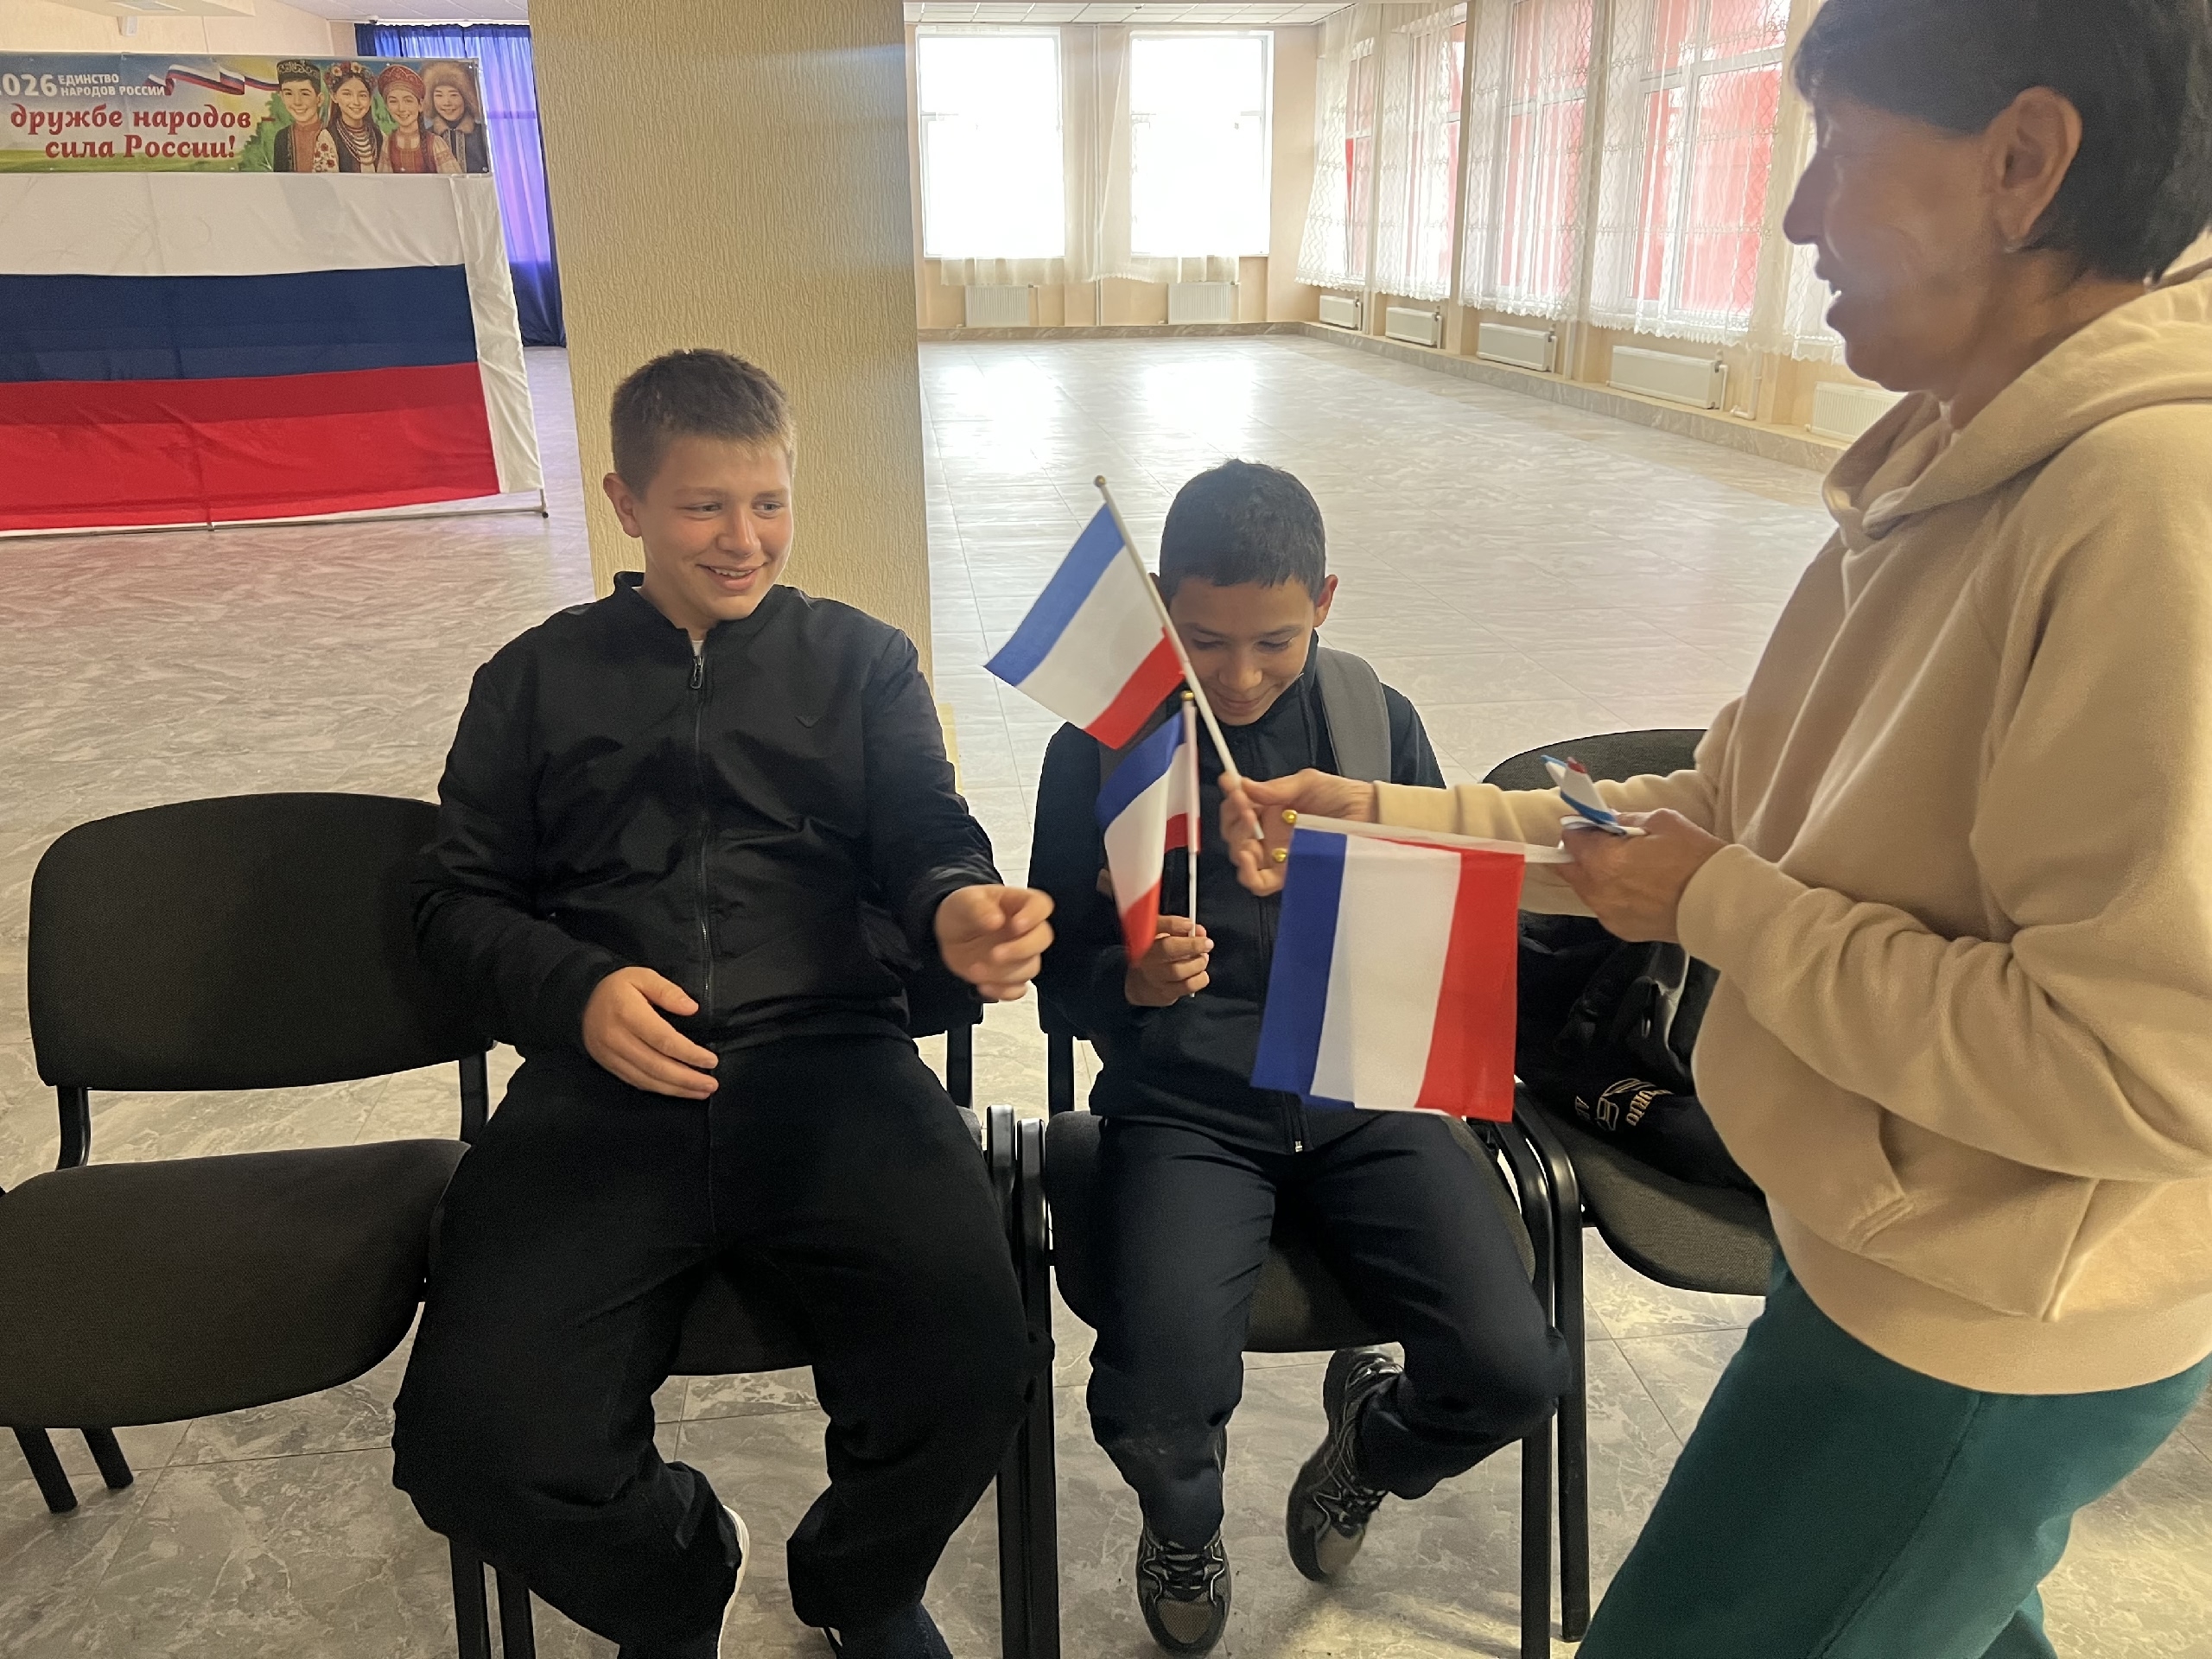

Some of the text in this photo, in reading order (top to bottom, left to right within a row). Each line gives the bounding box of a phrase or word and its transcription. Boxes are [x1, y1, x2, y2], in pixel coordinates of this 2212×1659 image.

[0, 73, 58, 98] 026
[57, 73, 119, 86] ЕДИНСТВО
[60, 86, 165, 97] НАРОДОВ РОССИИ
[10, 103, 124, 136] дружбе
[132, 104, 251, 136] народов
[45, 134, 236, 159] сила России!
